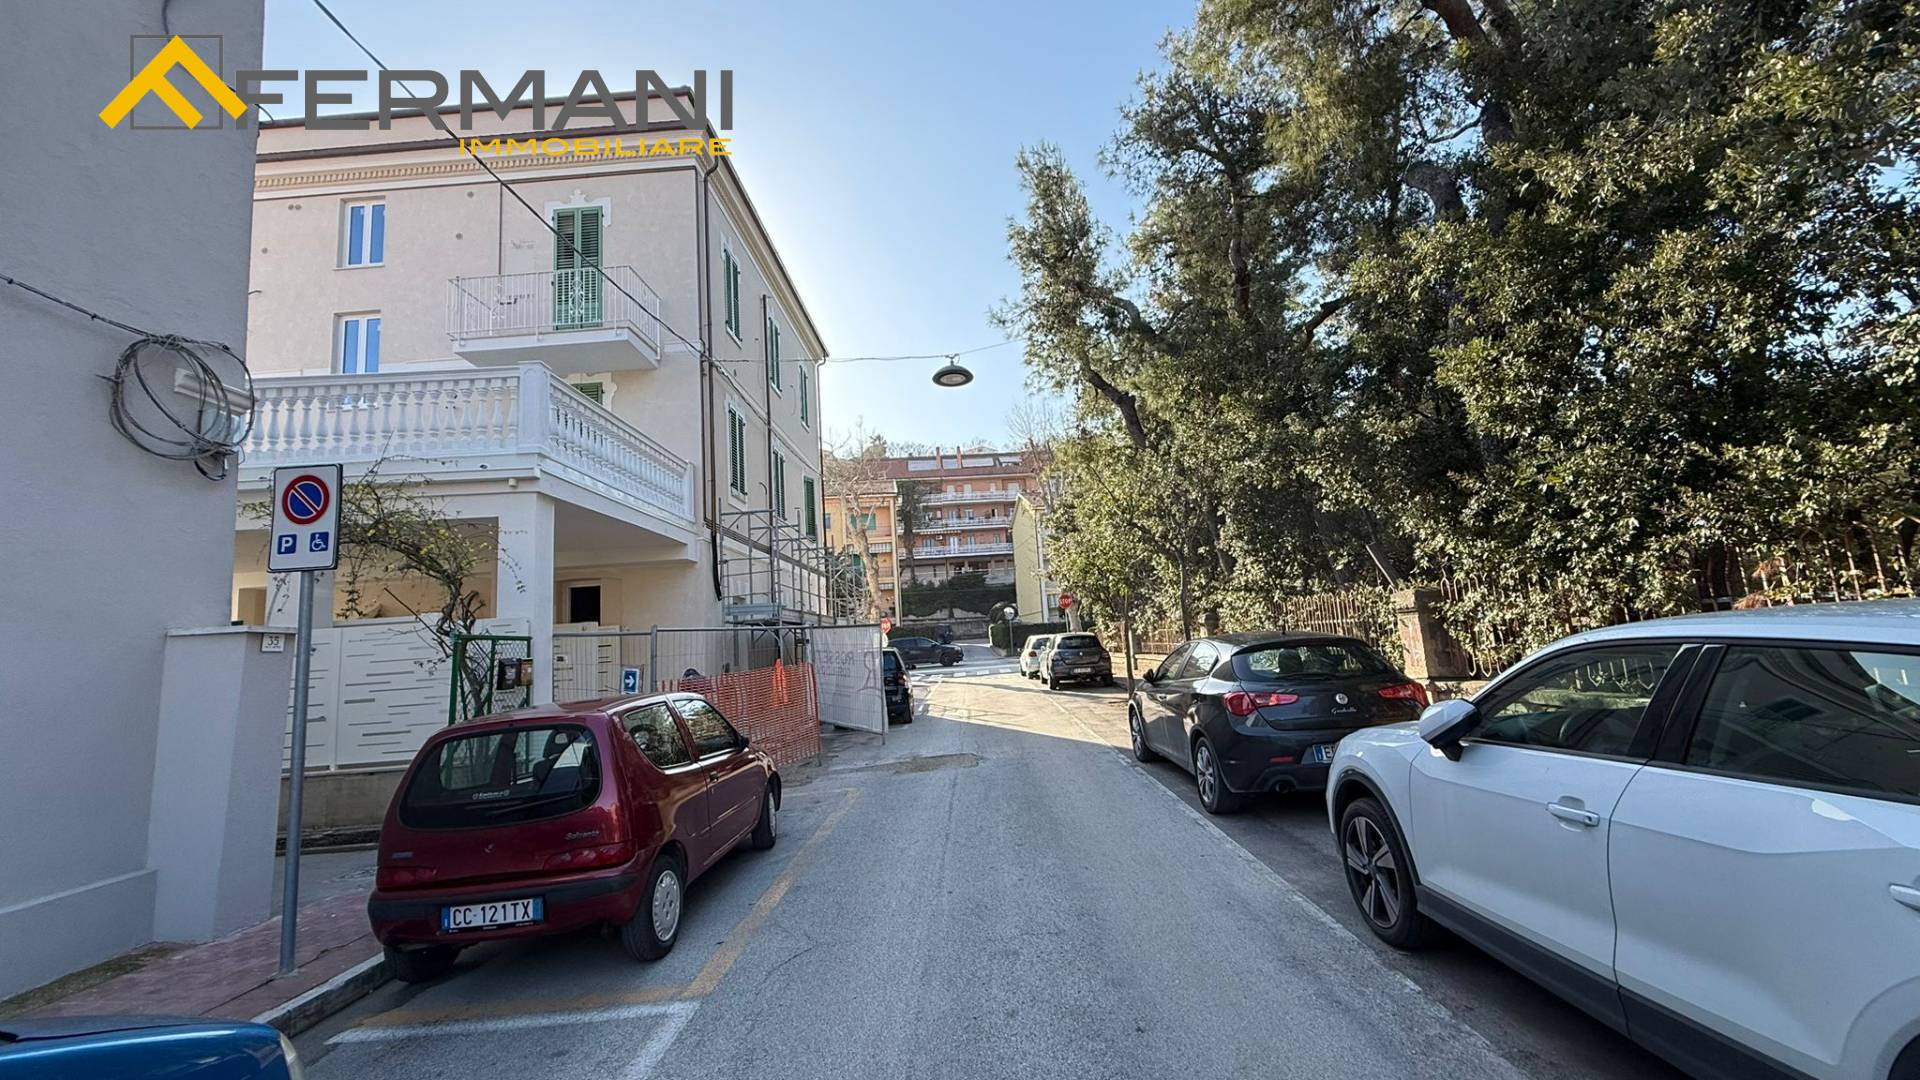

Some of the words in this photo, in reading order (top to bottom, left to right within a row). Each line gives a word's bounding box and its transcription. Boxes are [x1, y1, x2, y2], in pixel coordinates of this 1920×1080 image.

[281, 536, 293, 552] P
[453, 907, 472, 926] CC
[481, 901, 530, 924] 121TX
